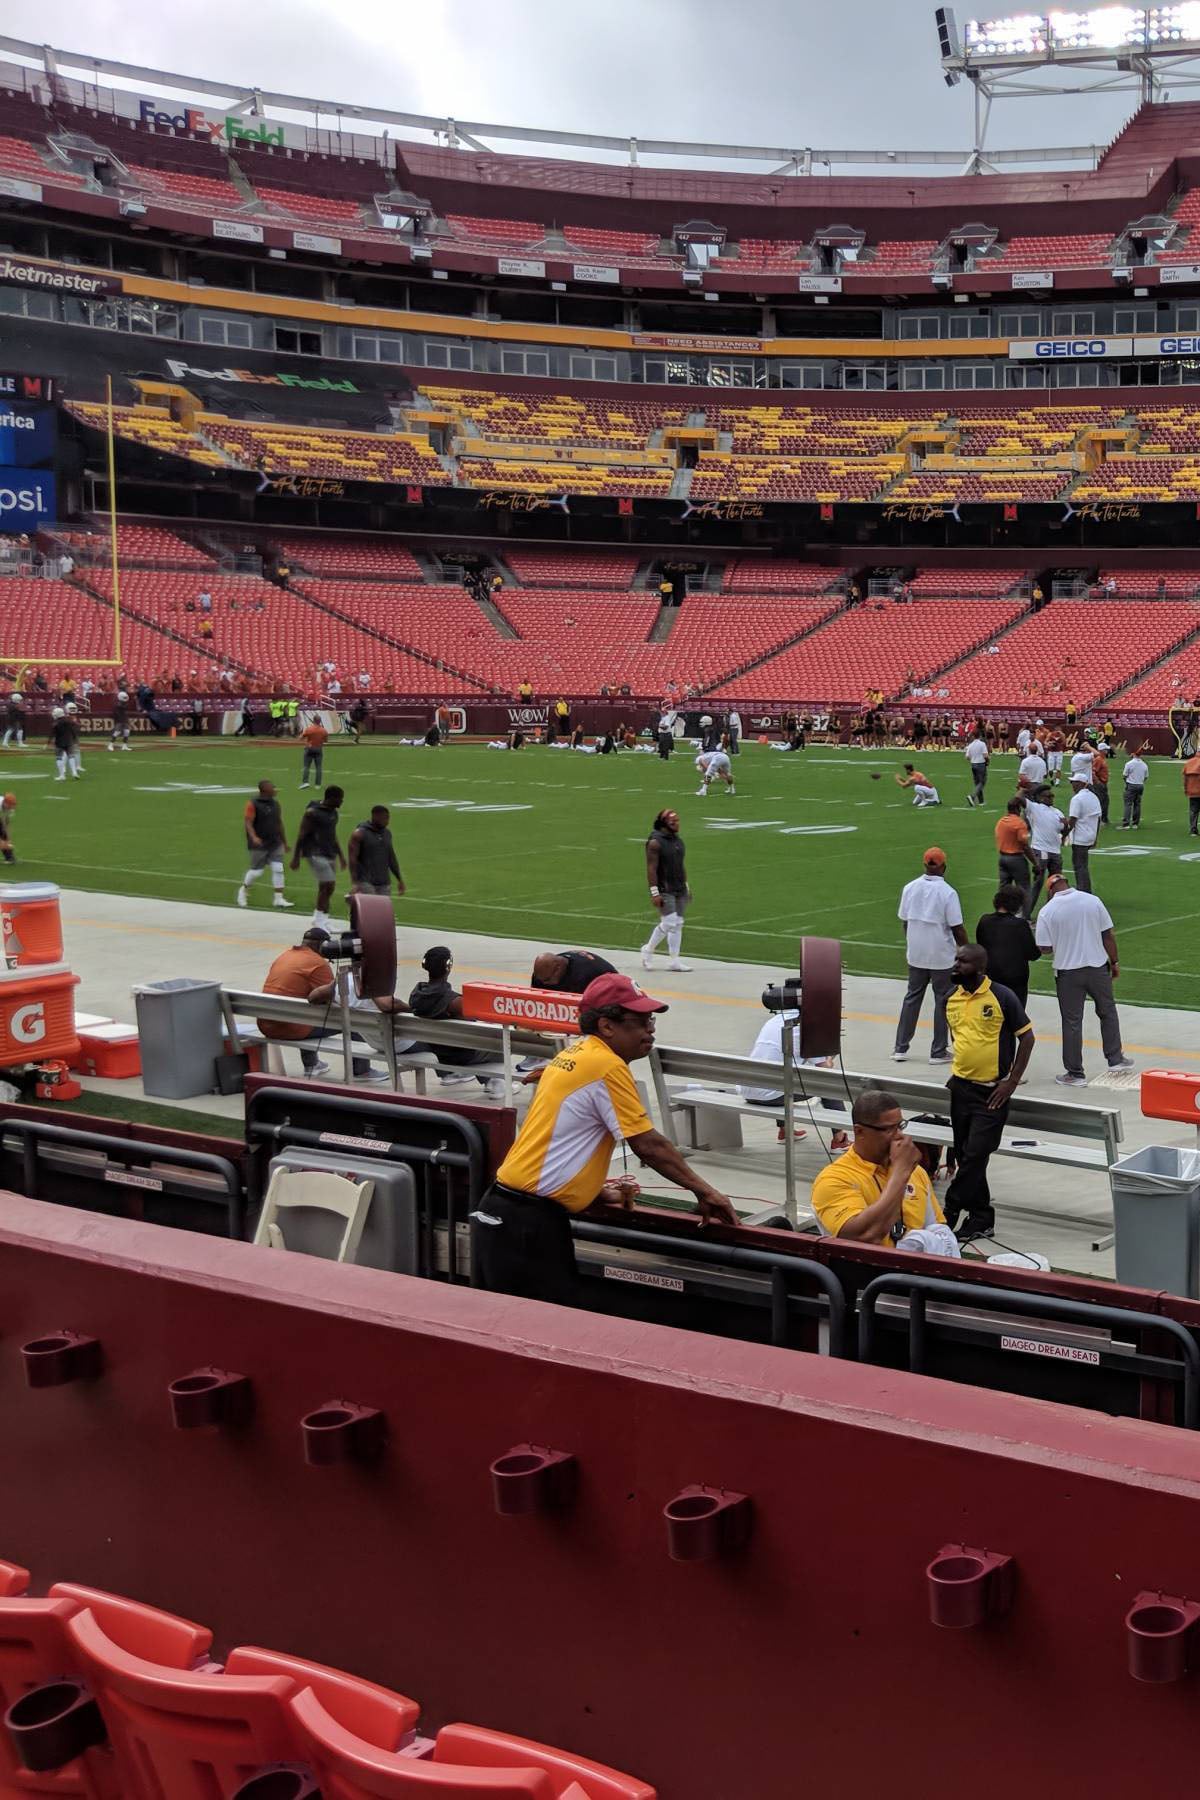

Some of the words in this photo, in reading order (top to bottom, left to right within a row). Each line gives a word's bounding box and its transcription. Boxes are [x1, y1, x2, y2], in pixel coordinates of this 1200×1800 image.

[1035, 340, 1106, 356] GEICO
[165, 358, 361, 393] FedExField
[507, 705, 550, 722] WOW!
[492, 996, 579, 1023] GATORADE
[10, 1002, 47, 1043] G
[605, 1267, 633, 1280] DIAGEO
[634, 1273, 660, 1285] DREAM
[661, 1278, 682, 1290] SEATS
[1002, 1338, 1036, 1352] DIAGEO
[1038, 1344, 1070, 1358] DREAM
[1071, 1349, 1098, 1363] SEATS
